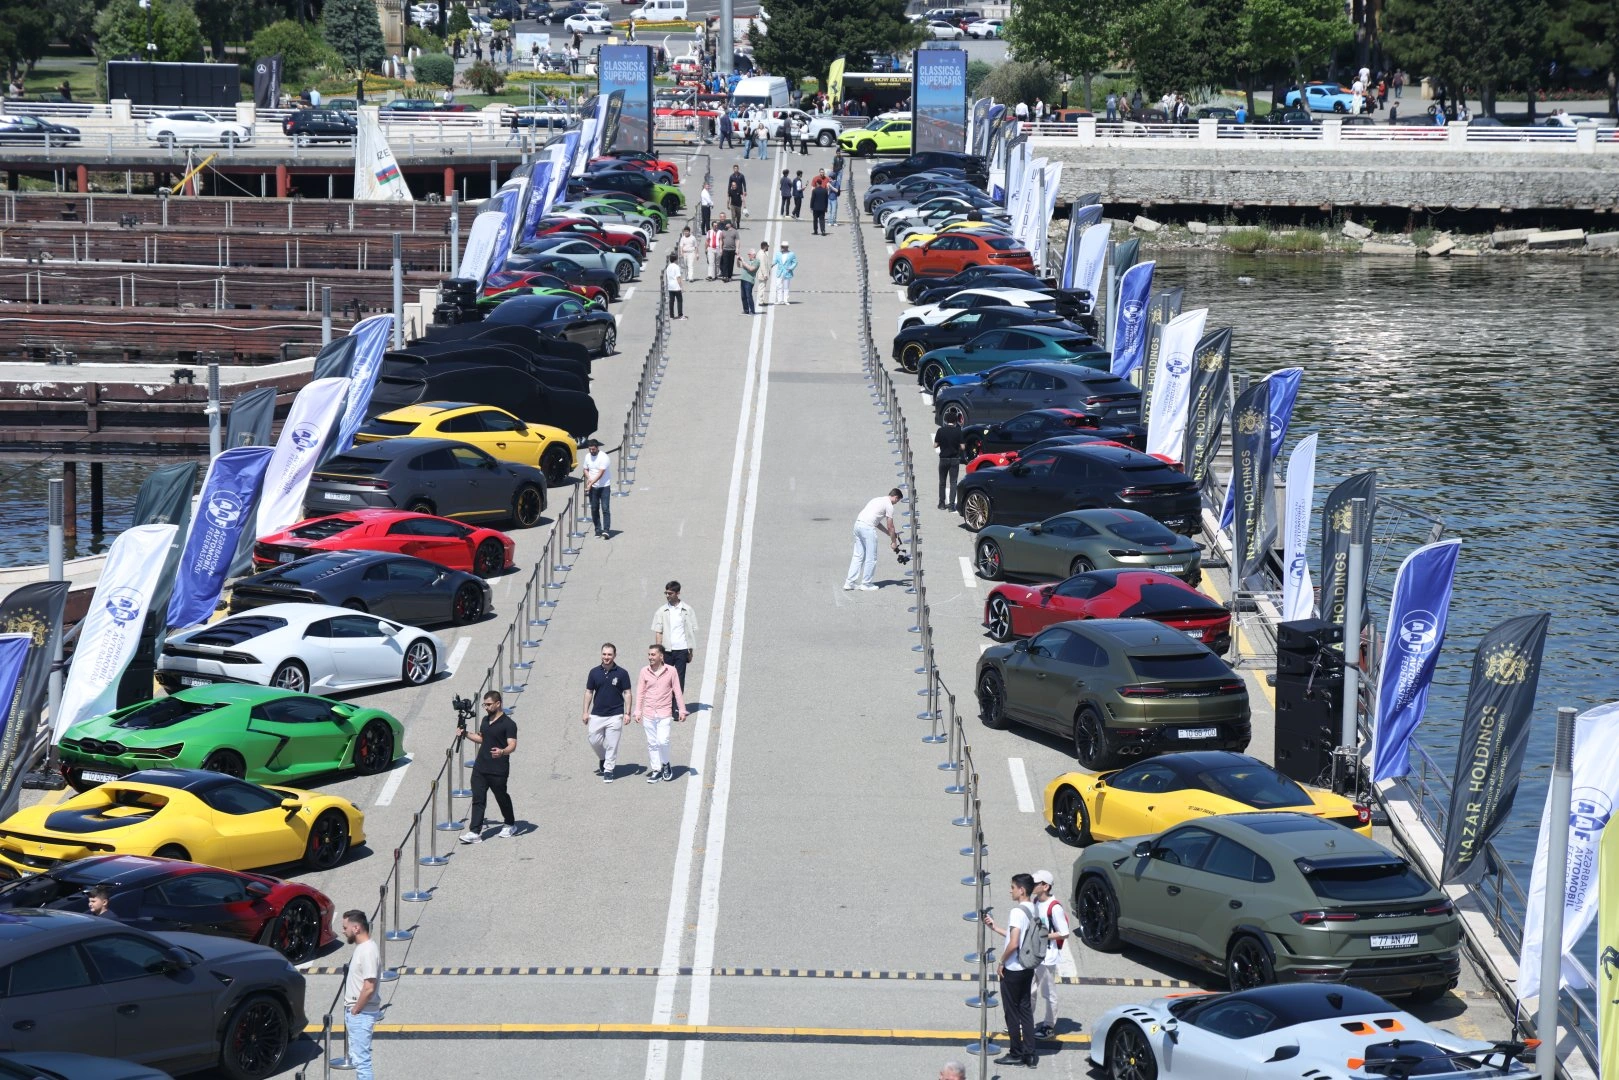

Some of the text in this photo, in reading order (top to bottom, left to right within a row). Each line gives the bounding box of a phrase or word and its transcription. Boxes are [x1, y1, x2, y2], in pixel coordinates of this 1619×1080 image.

[603, 60, 645, 71] CLASSICS &
[603, 70, 647, 81] SUPERCARS
[920, 65, 961, 76] CLASSICS &
[920, 75, 962, 86] SUPERCARS
[1148, 337, 1160, 385] HOLDINGS
[1196, 385, 1208, 438] HOLDINGS
[215, 500, 232, 528] AAF
[1241, 450, 1255, 561] NAZAR HOLDINGS
[1333, 552, 1346, 625] HOLDINGS
[1408, 622, 1425, 655] AAF
[1458, 705, 1497, 862] NAZAR HOLDINGS
[1574, 801, 1595, 842] AAF
[1574, 847, 1593, 913] AZƏRBAYCAN
[1378, 933, 1417, 945] 77 AN 777
